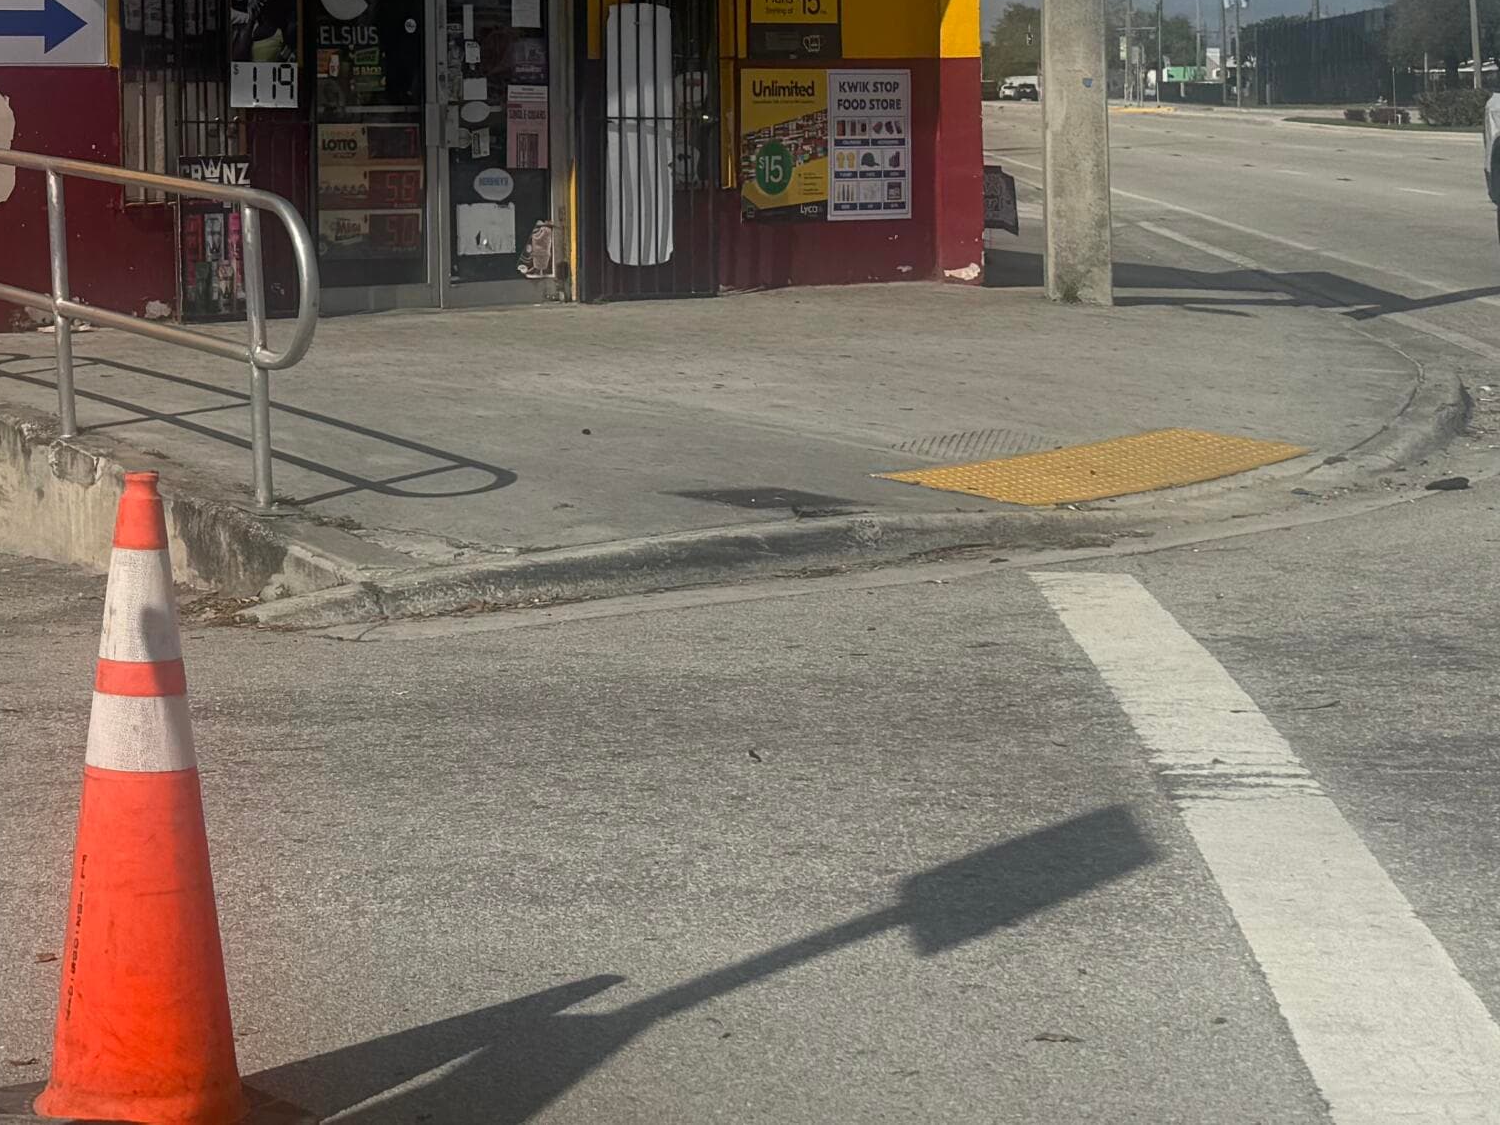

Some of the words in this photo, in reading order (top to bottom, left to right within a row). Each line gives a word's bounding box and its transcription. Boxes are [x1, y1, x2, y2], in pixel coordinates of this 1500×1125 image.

[316, 26, 379, 45] ELSIUS
[752, 79, 816, 97] Unlimited
[838, 81, 870, 93] KWIK
[872, 81, 900, 93] STOP
[837, 98, 867, 111] FOOD
[868, 98, 902, 111] STORE
[322, 138, 357, 151] LOTTO
[758, 154, 784, 184] $15
[799, 203, 818, 217] Lyca
